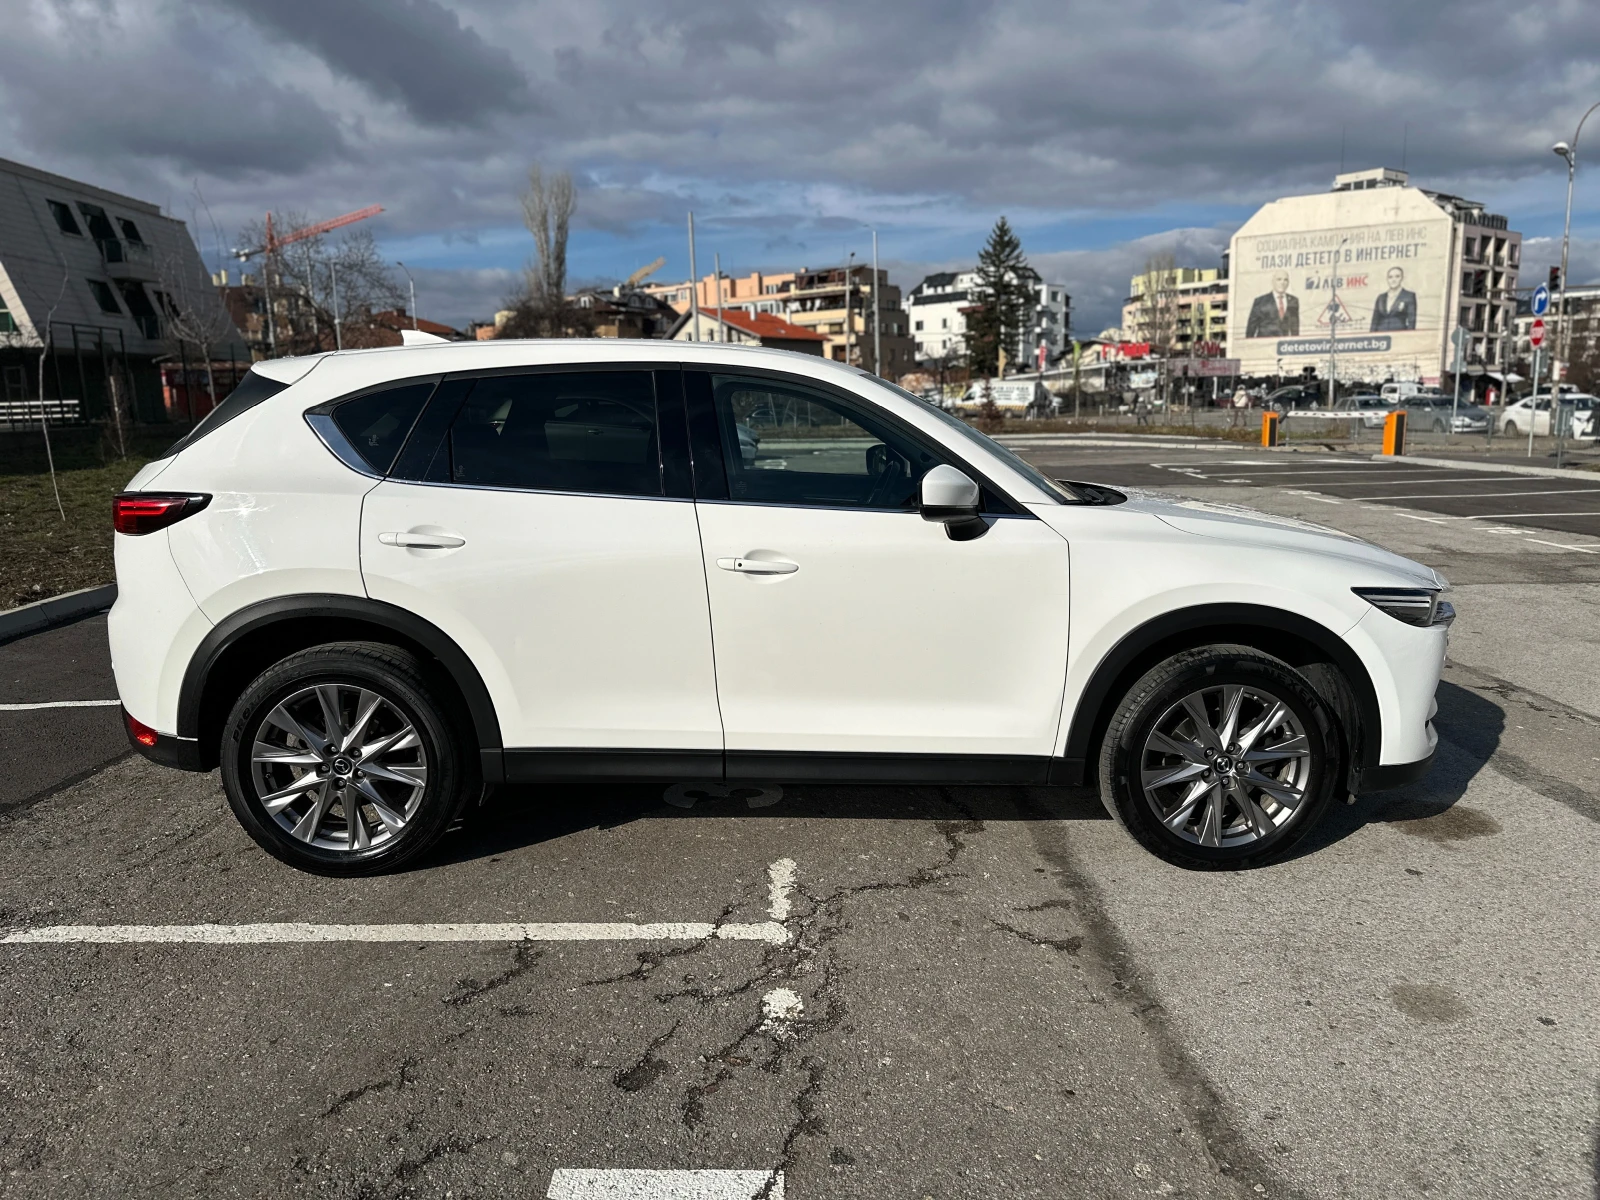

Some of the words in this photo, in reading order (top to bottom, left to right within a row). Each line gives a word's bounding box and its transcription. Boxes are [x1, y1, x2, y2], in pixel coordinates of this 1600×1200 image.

[1256, 236, 1308, 253] СОЦИАЛНА
[1368, 230, 1381, 244] НА
[1384, 228, 1404, 242] ЛЕВ
[1406, 226, 1427, 240] ИНС
[1295, 249, 1340, 268] ДЕТЕТО
[1344, 248, 1352, 263] В
[1346, 275, 1368, 287] ИНС
[1262, 666, 1318, 711] NEXEN
